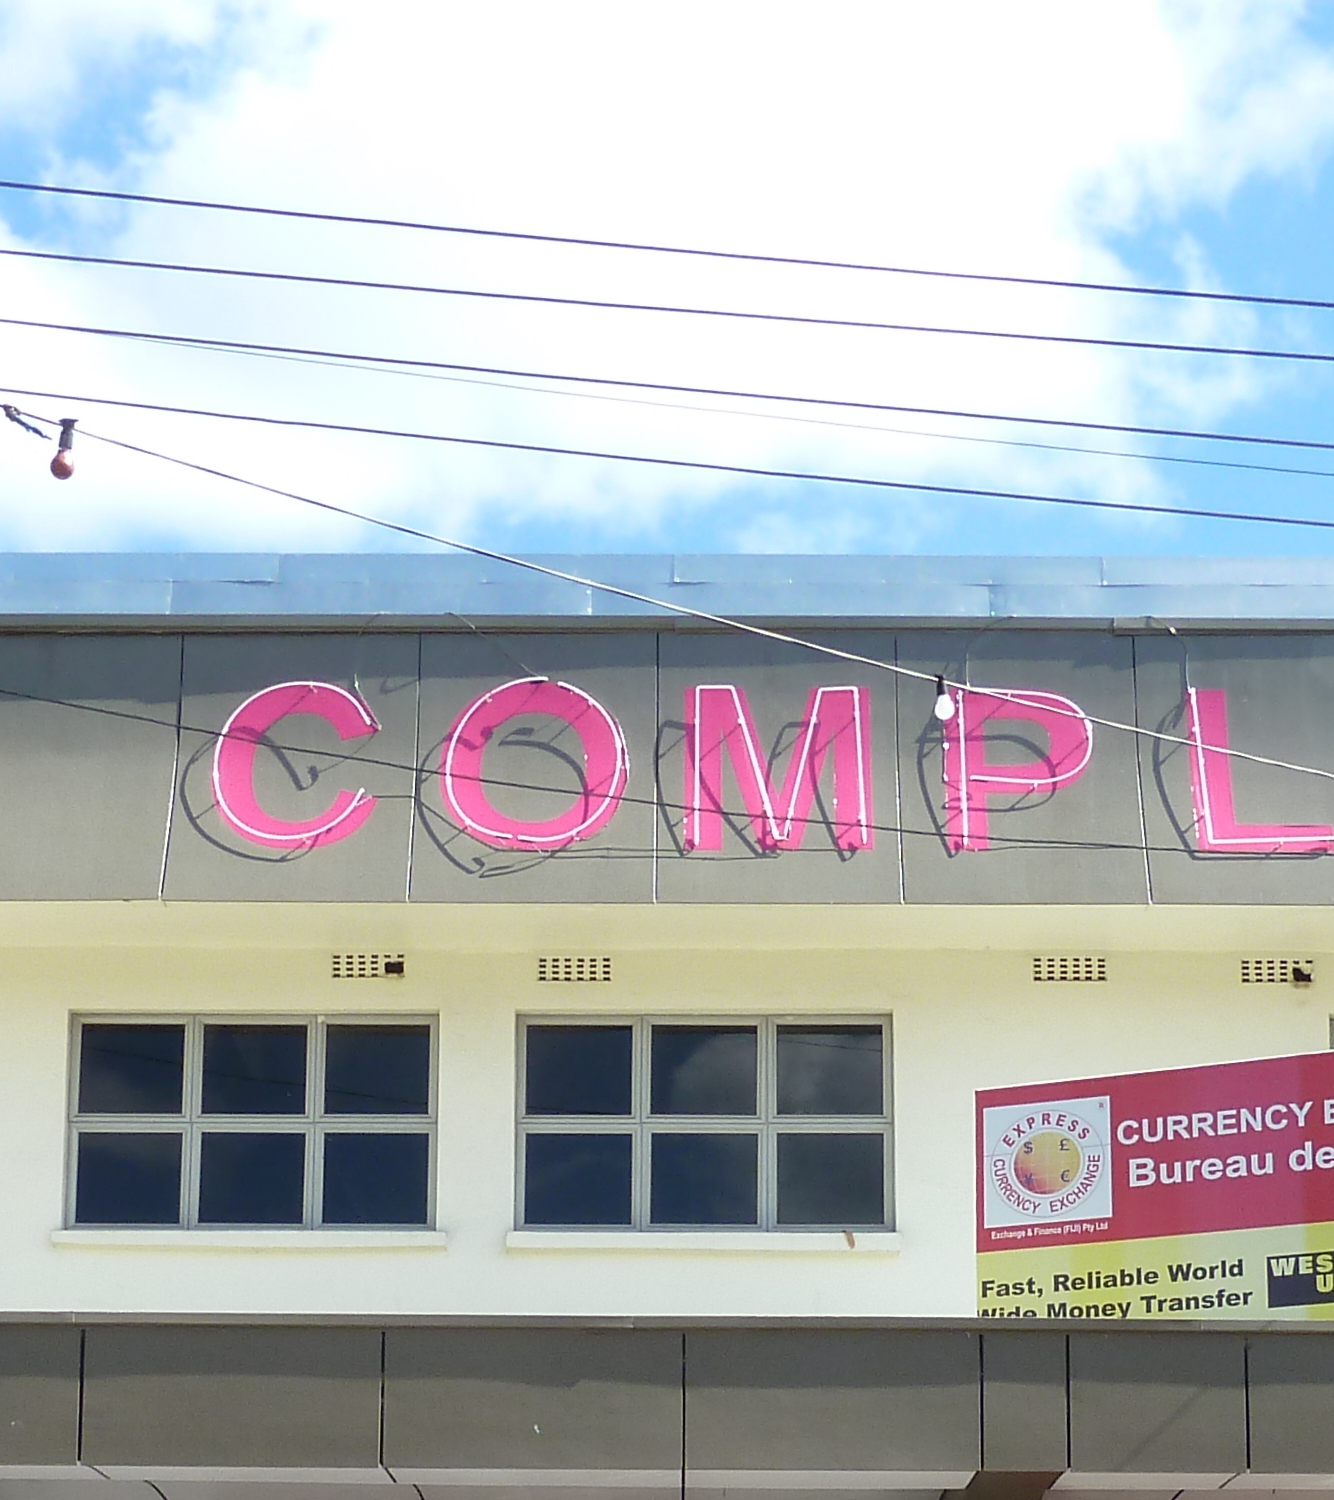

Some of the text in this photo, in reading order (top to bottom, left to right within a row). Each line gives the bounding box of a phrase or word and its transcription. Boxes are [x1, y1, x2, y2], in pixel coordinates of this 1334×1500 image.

[1002, 1112, 1091, 1148] EXPRESS
[1117, 1101, 1313, 1145] CURRENCY
[993, 1154, 1101, 1214] CURRENCY EXCHANGE
[1128, 1150, 1275, 1187] Bureau
[1096, 1221, 1109, 1230] Ltd
[981, 1259, 1244, 1298] Fast, Reliable World
[1047, 1301, 1131, 1318] Money
[1140, 1289, 1253, 1313] Transfer
